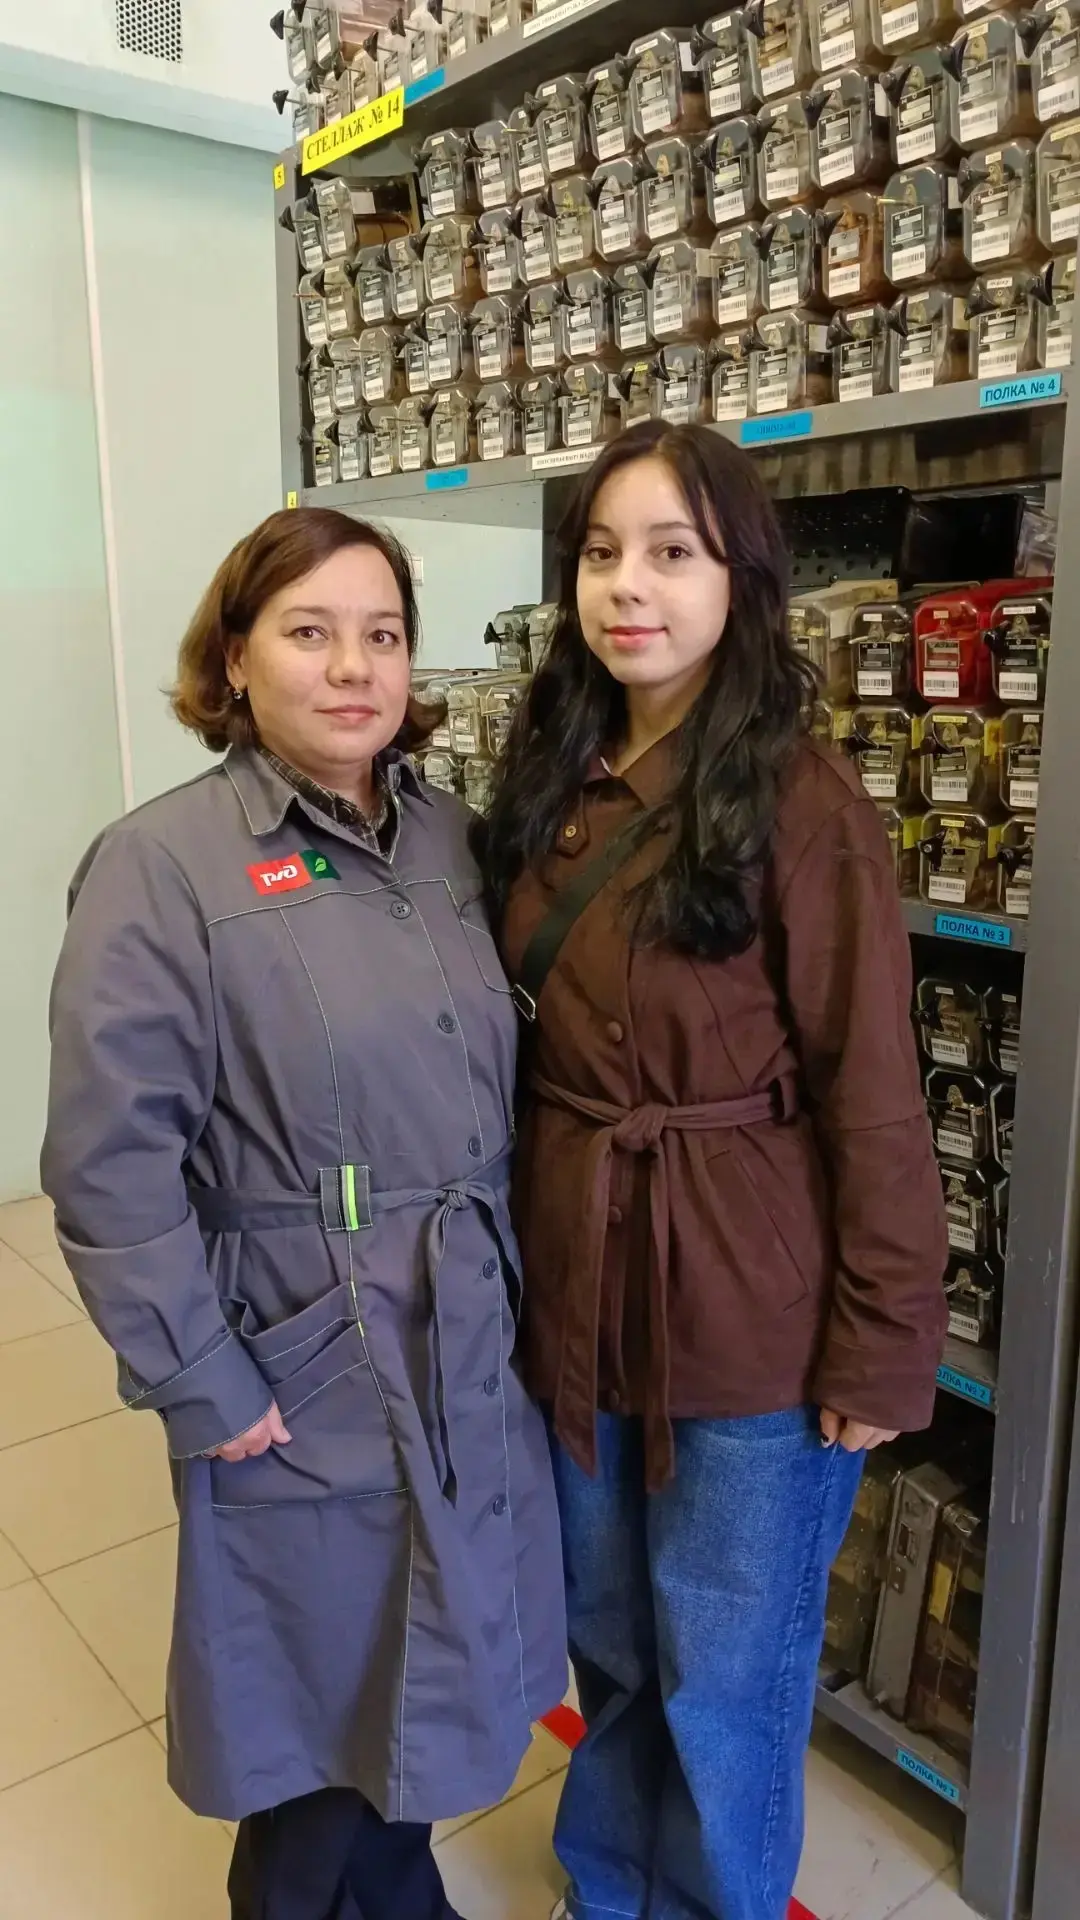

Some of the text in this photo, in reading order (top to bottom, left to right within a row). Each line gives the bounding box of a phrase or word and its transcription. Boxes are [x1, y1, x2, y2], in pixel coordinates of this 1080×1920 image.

[306, 95, 400, 160] СТЕЛЛАЖ № 14
[985, 379, 1056, 402] ПОЛКА № 4
[941, 920, 1005, 941] ПОЛКА № 3
[936, 1368, 986, 1399] ОЛКА № 2
[902, 1754, 955, 1798] ПОЛКА № 1
